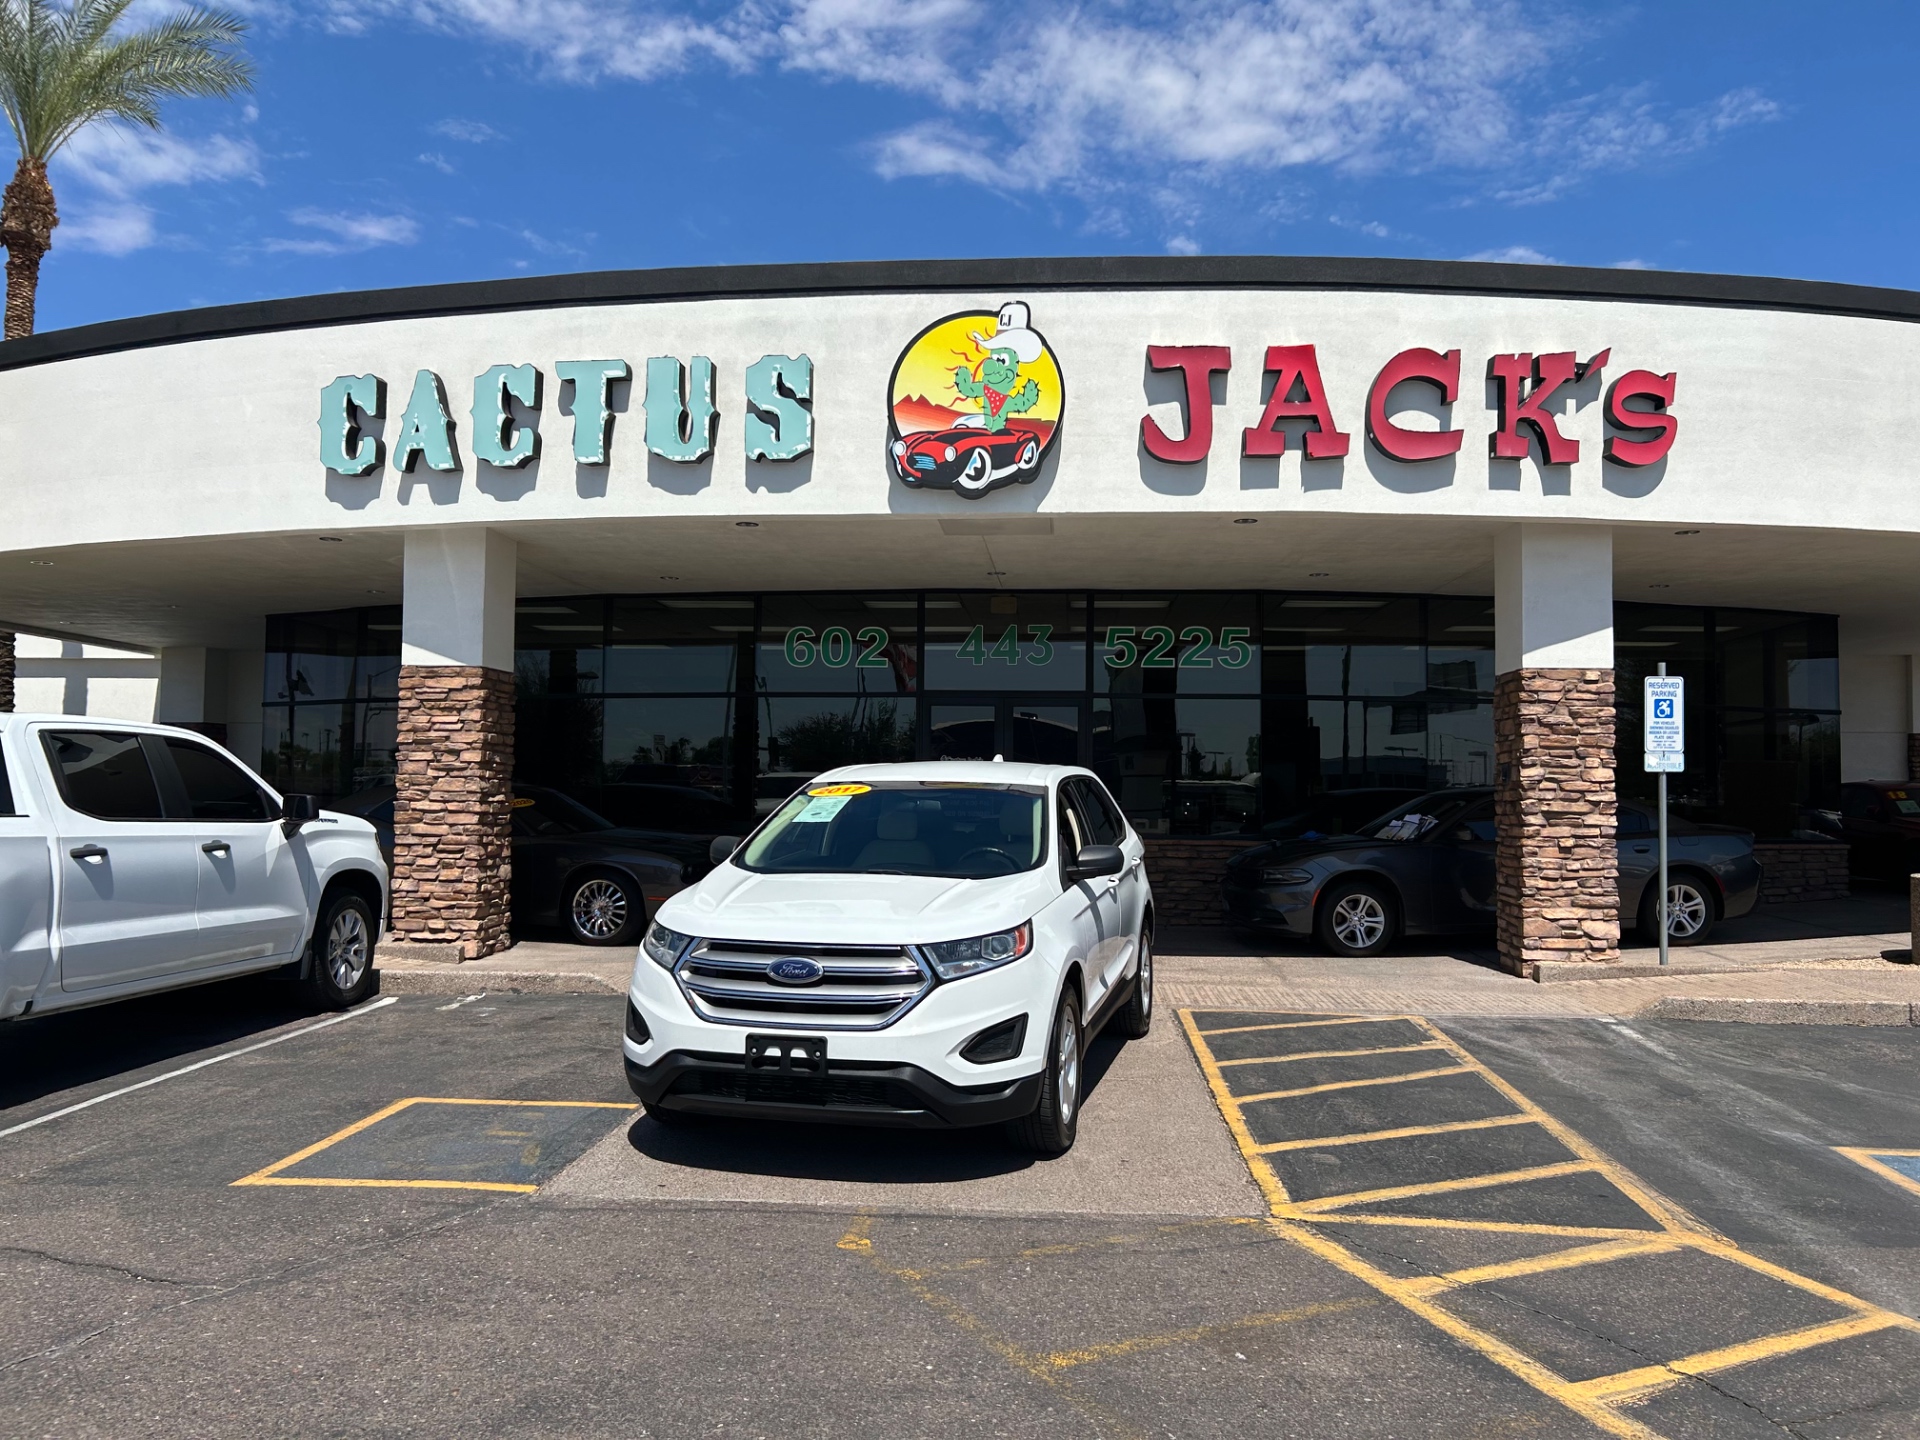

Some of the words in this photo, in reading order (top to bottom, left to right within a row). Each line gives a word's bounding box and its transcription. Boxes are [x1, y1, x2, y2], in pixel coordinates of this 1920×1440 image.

[317, 353, 814, 477] CACTUS
[783, 626, 890, 668] 602
[955, 624, 1054, 666] 443
[1103, 626, 1253, 669] 5225
[1648, 682, 1680, 690] RESERVED
[1651, 690, 1678, 698] PARKING
[779, 962, 809, 977] Ford
